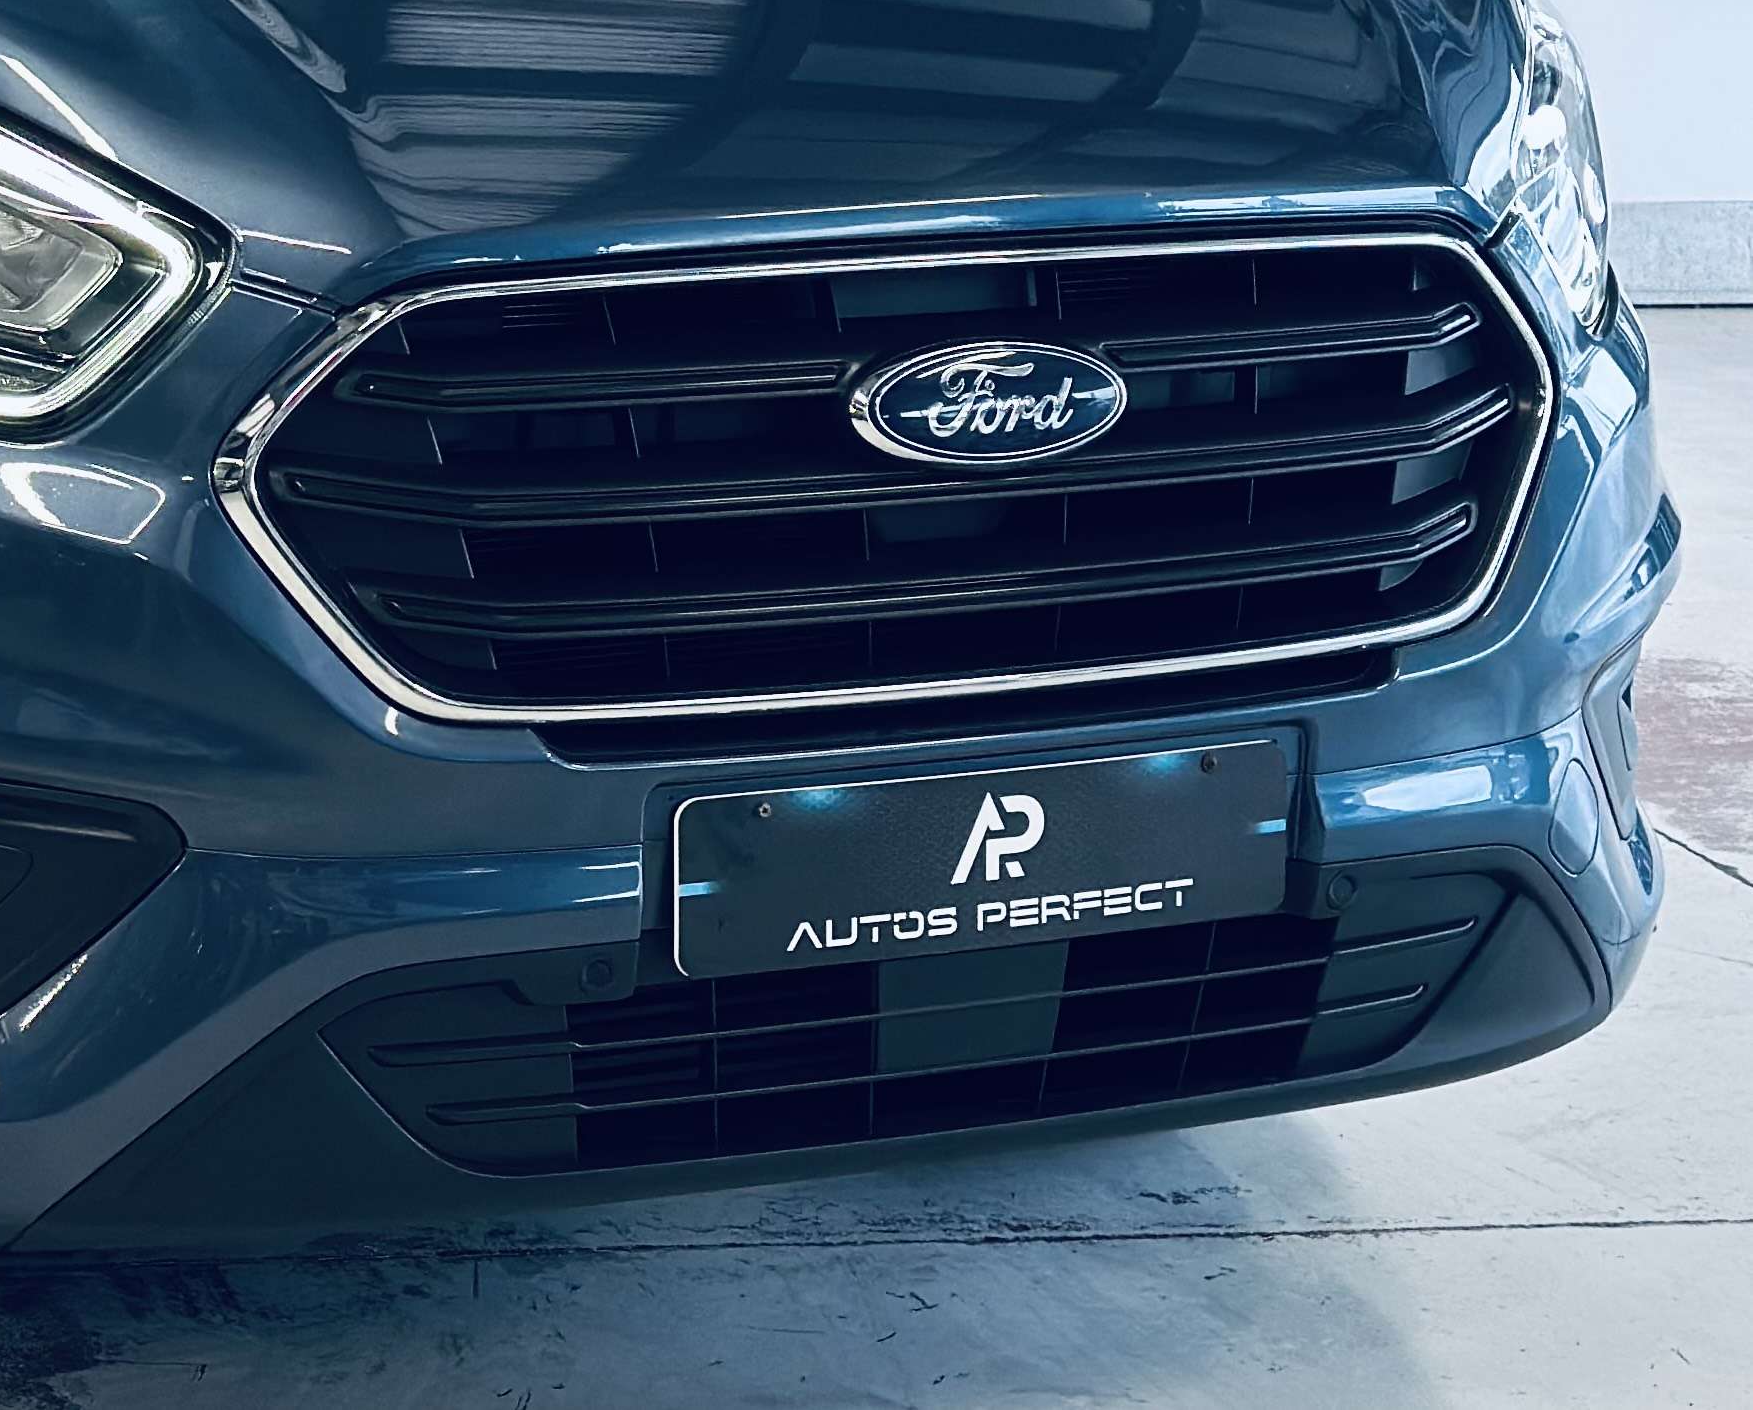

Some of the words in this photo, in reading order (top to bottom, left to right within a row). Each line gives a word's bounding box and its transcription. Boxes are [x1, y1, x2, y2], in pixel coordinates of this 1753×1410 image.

[928, 359, 1074, 438] Ford
[786, 906, 958, 952] AUTOS
[976, 877, 1194, 932] PERFECT
